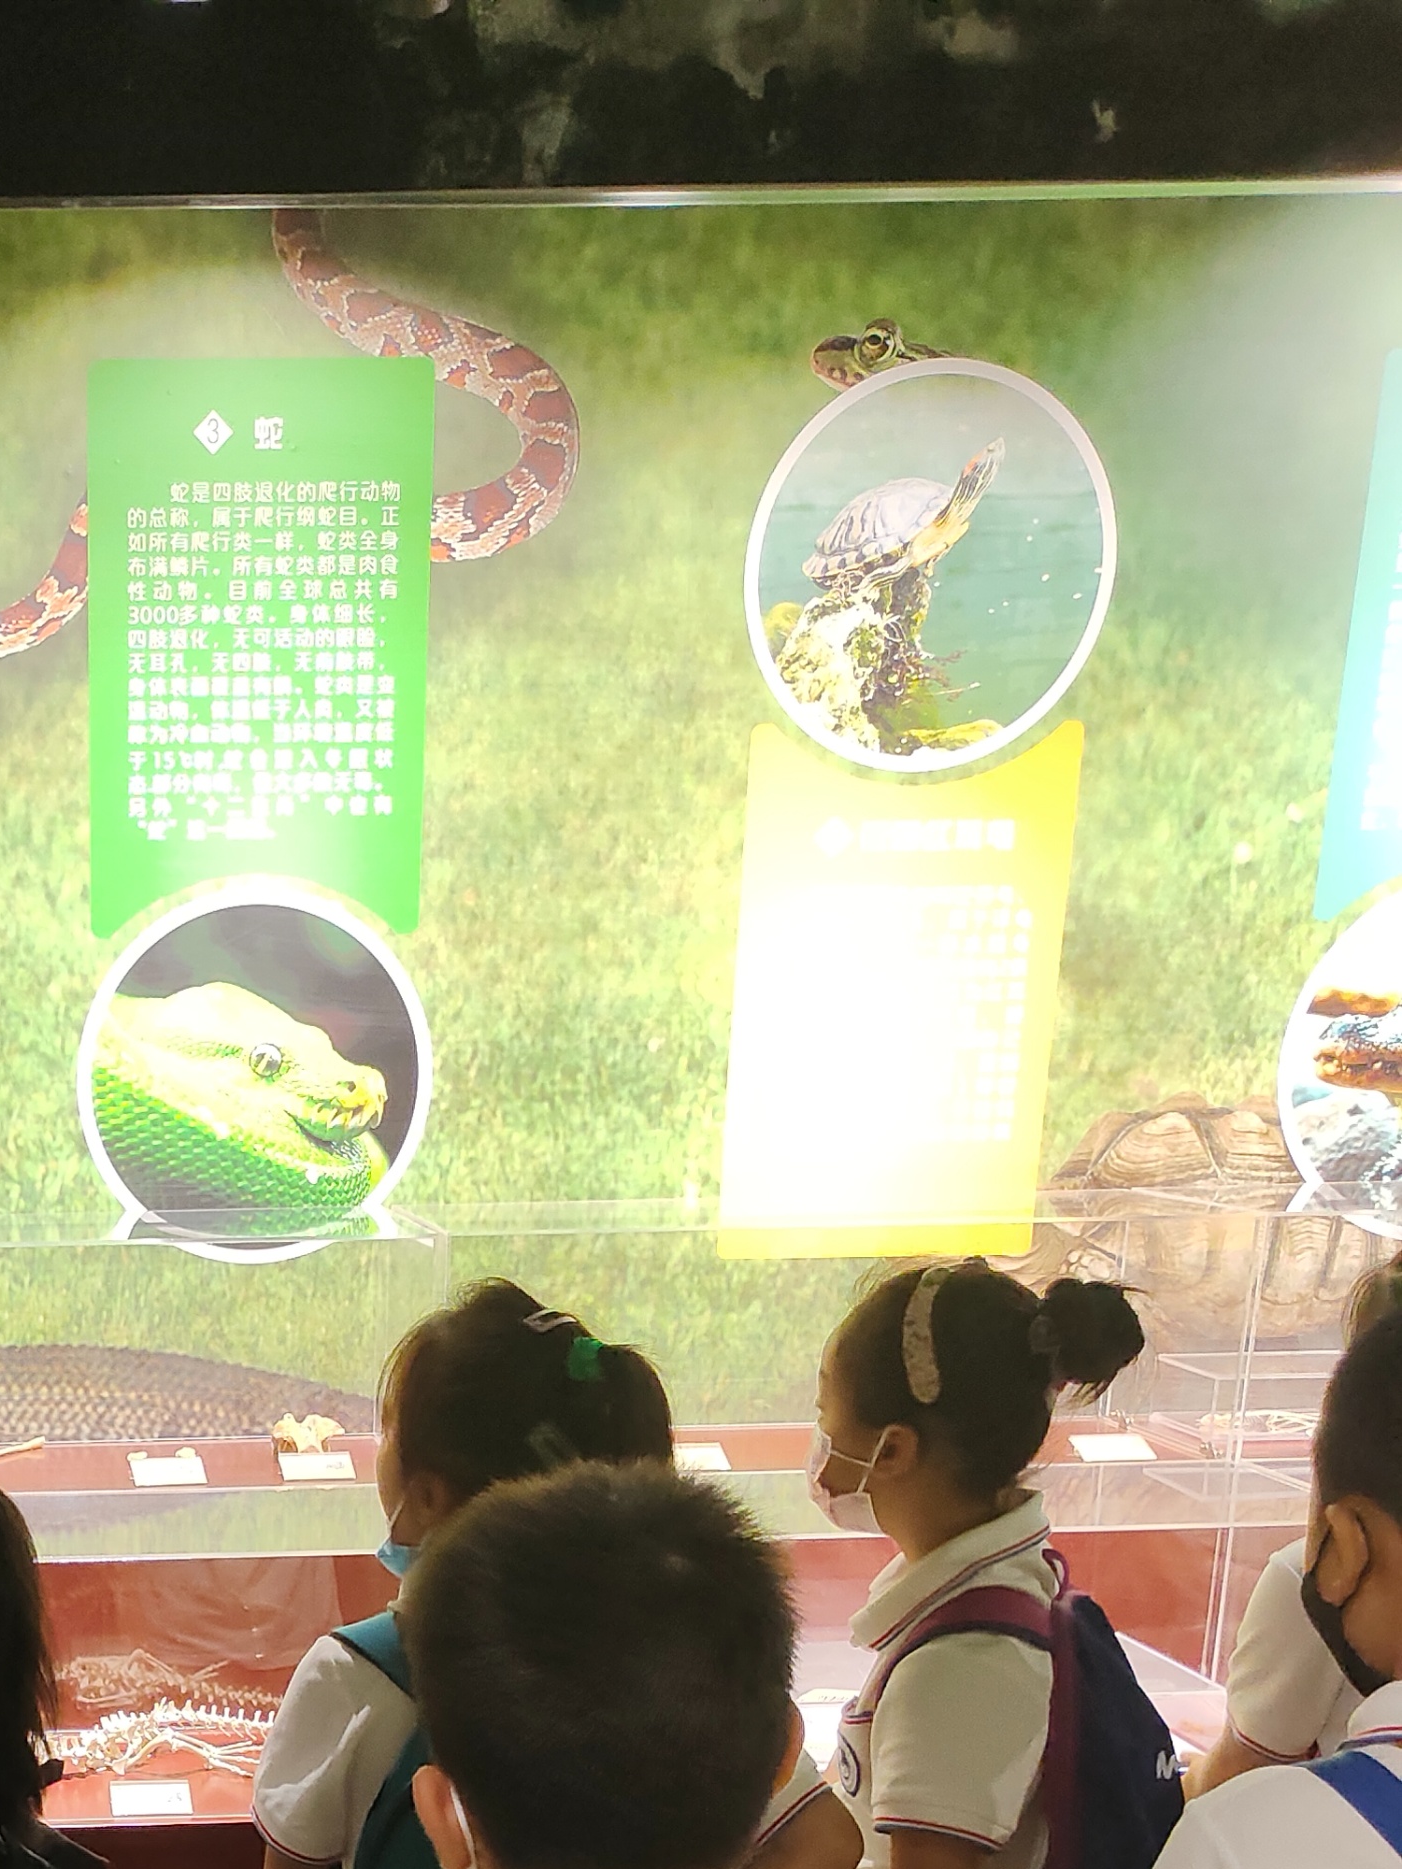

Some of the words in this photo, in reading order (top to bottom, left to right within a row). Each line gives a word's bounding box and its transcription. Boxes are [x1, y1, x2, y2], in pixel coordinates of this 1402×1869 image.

[206, 417, 220, 445] 3
[254, 416, 284, 450] 蛇
[170, 481, 401, 504] 蛇是四肢退化的爬行动物
[127, 506, 400, 528] 的总称，属于爬行纲蛇目。正
[127, 530, 399, 552] 如所有爬行类一样，蛇类全身
[127, 554, 399, 577] 布满鳞片。所有蛇类都是肉食
[127, 578, 398, 601] 性动物。目前全球总共有
